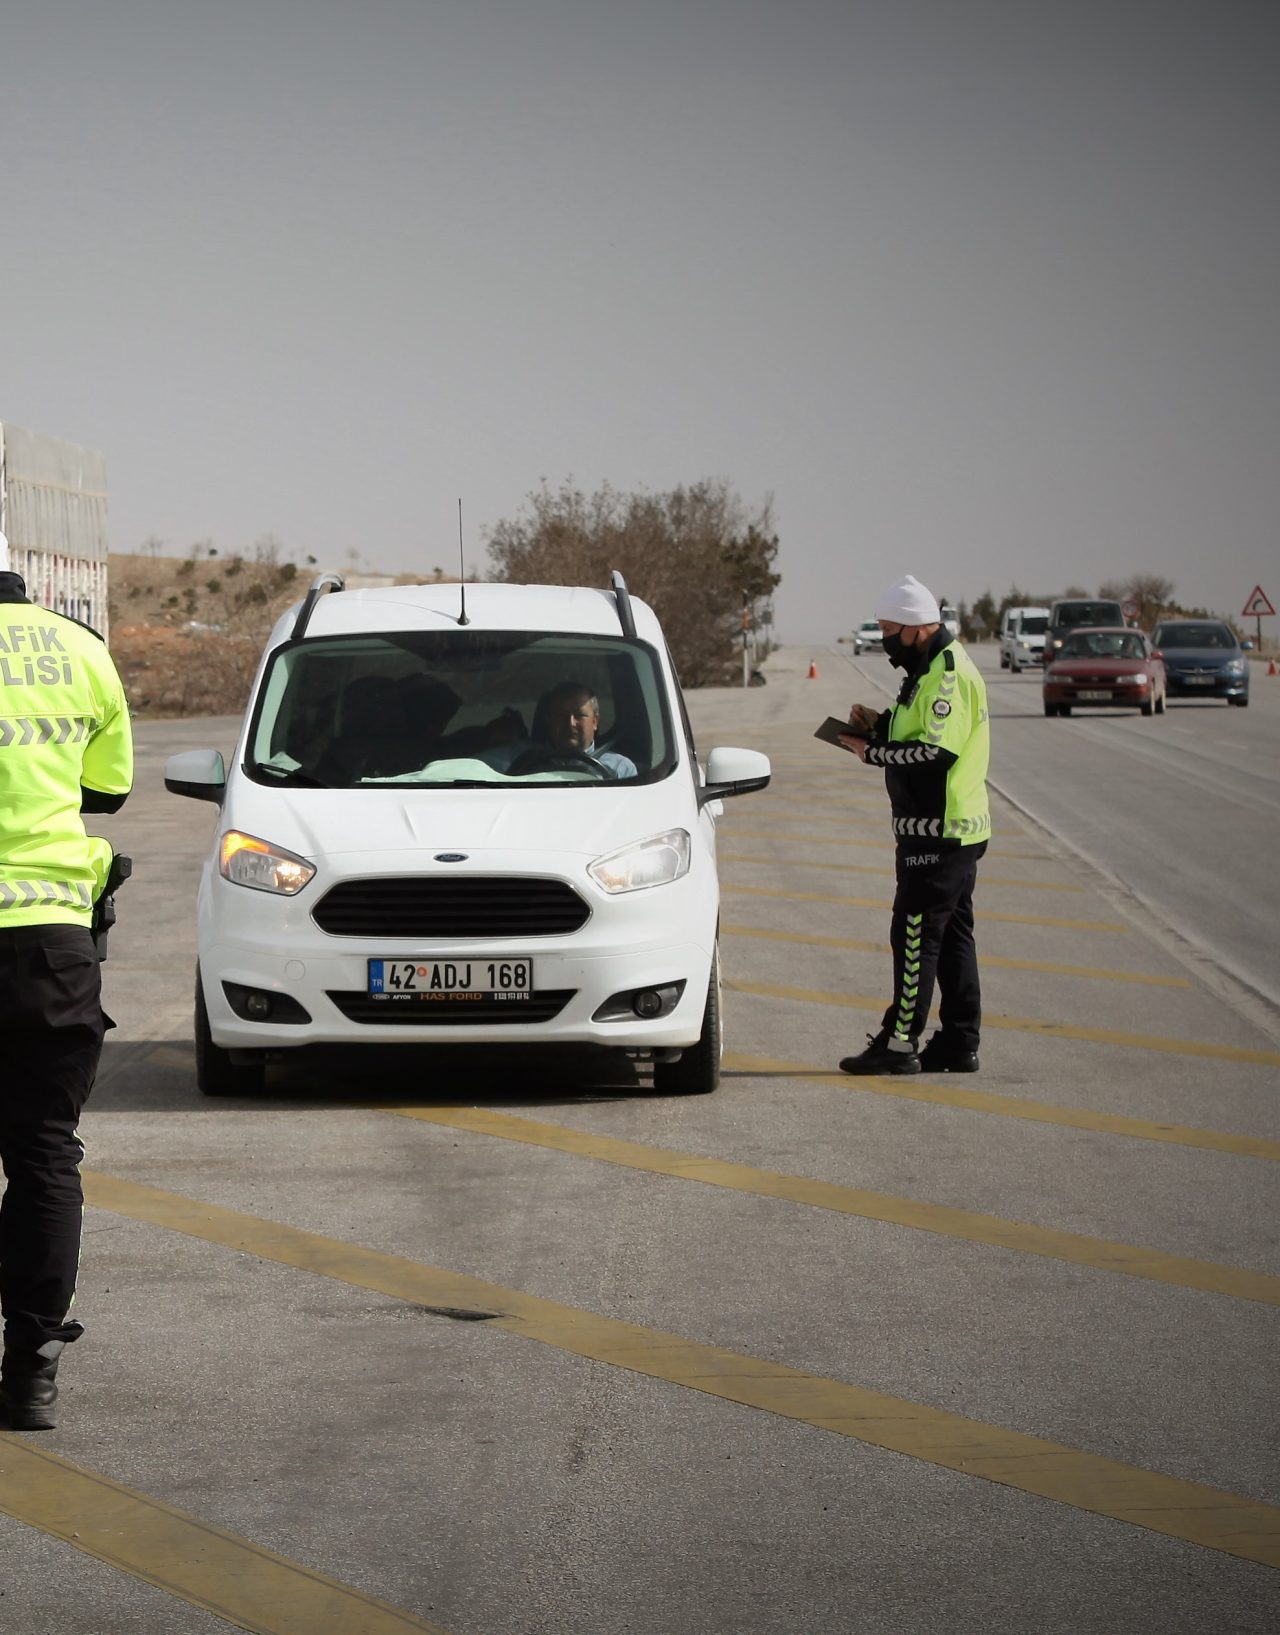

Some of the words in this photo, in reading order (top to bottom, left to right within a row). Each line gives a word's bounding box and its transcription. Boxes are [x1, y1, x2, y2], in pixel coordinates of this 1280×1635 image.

[389, 964, 416, 989] 42
[430, 964, 471, 989] ADJ
[487, 964, 527, 989] 168
[372, 979, 383, 987] TR
[420, 992, 445, 1000] HAS
[449, 992, 482, 1000] FORD
